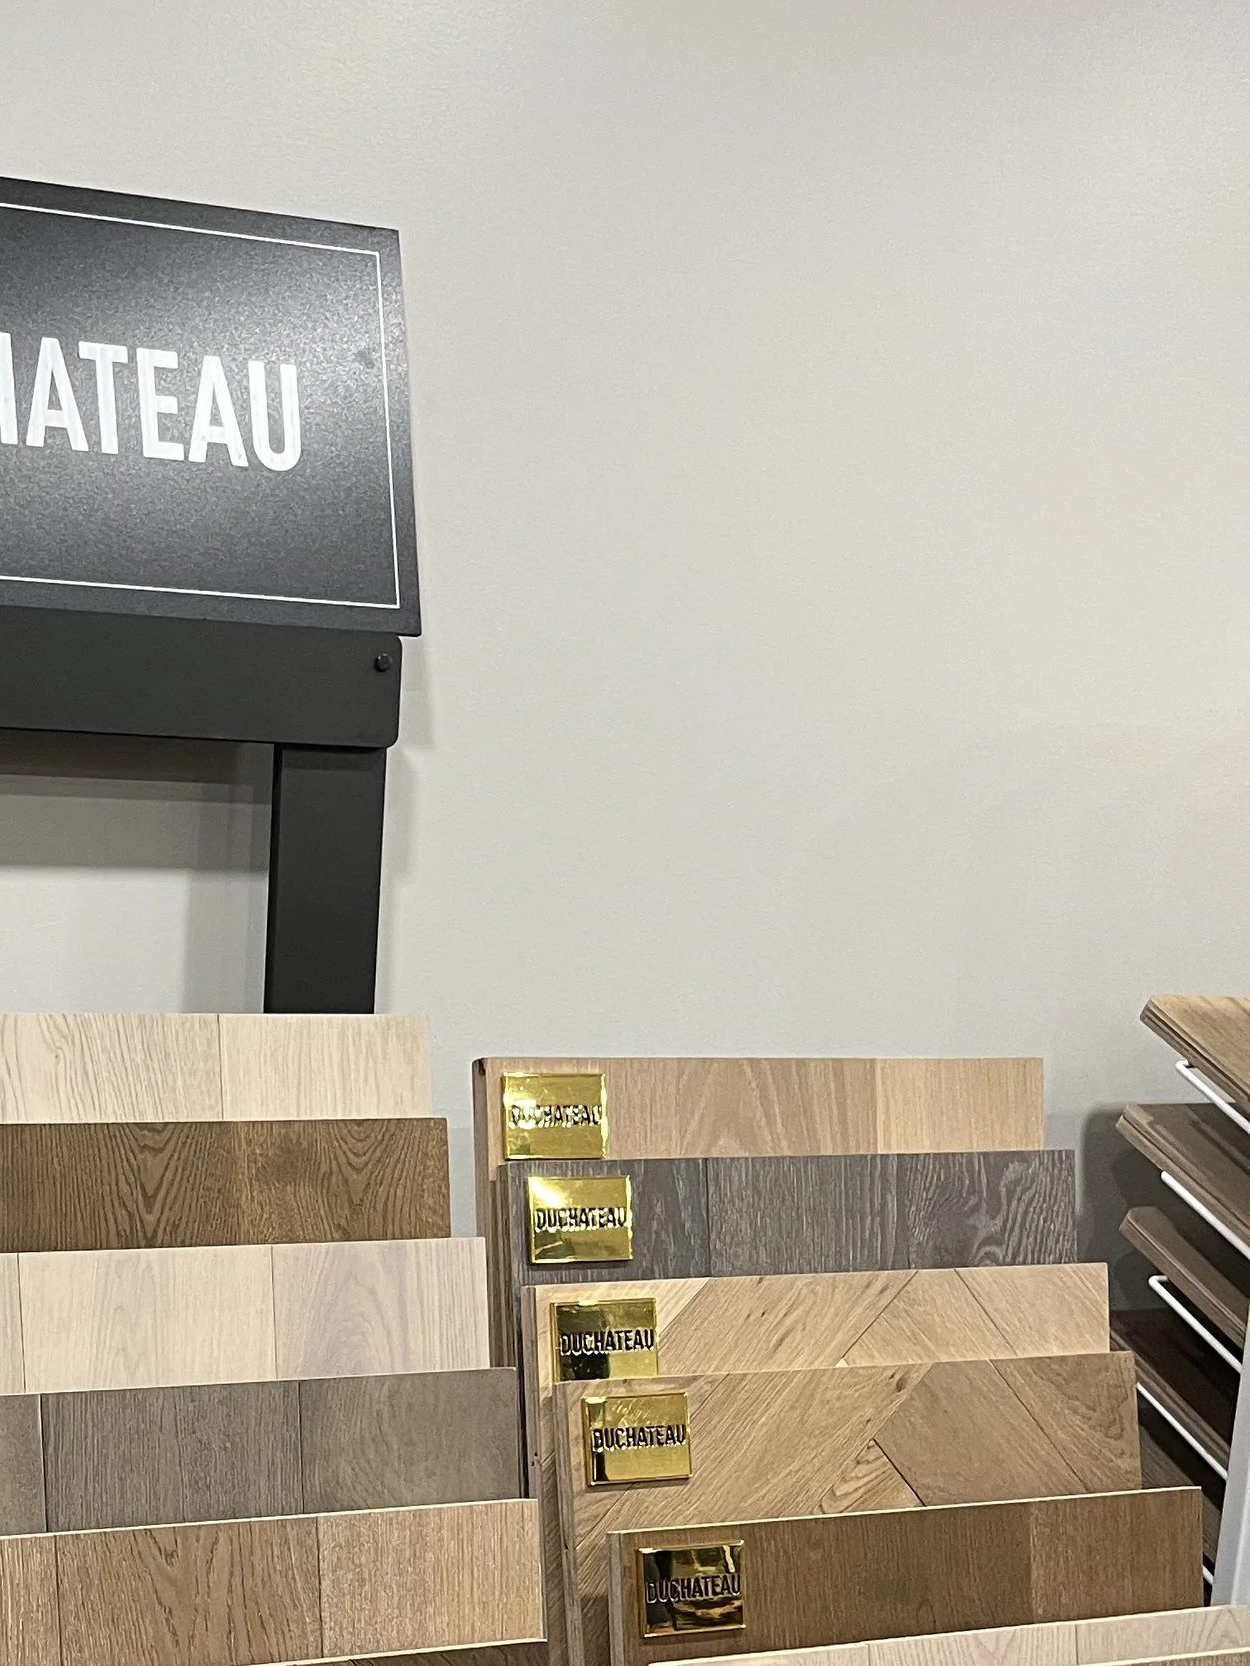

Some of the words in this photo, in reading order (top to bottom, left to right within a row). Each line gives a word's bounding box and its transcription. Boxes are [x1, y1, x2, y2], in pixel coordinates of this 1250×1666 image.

[535, 1207, 627, 1232] DUCHATEAU
[560, 1329, 654, 1355] DUCHATEAU
[592, 1424, 686, 1452] DUCHATEAU
[646, 1574, 741, 1603] DUCHATEAU
